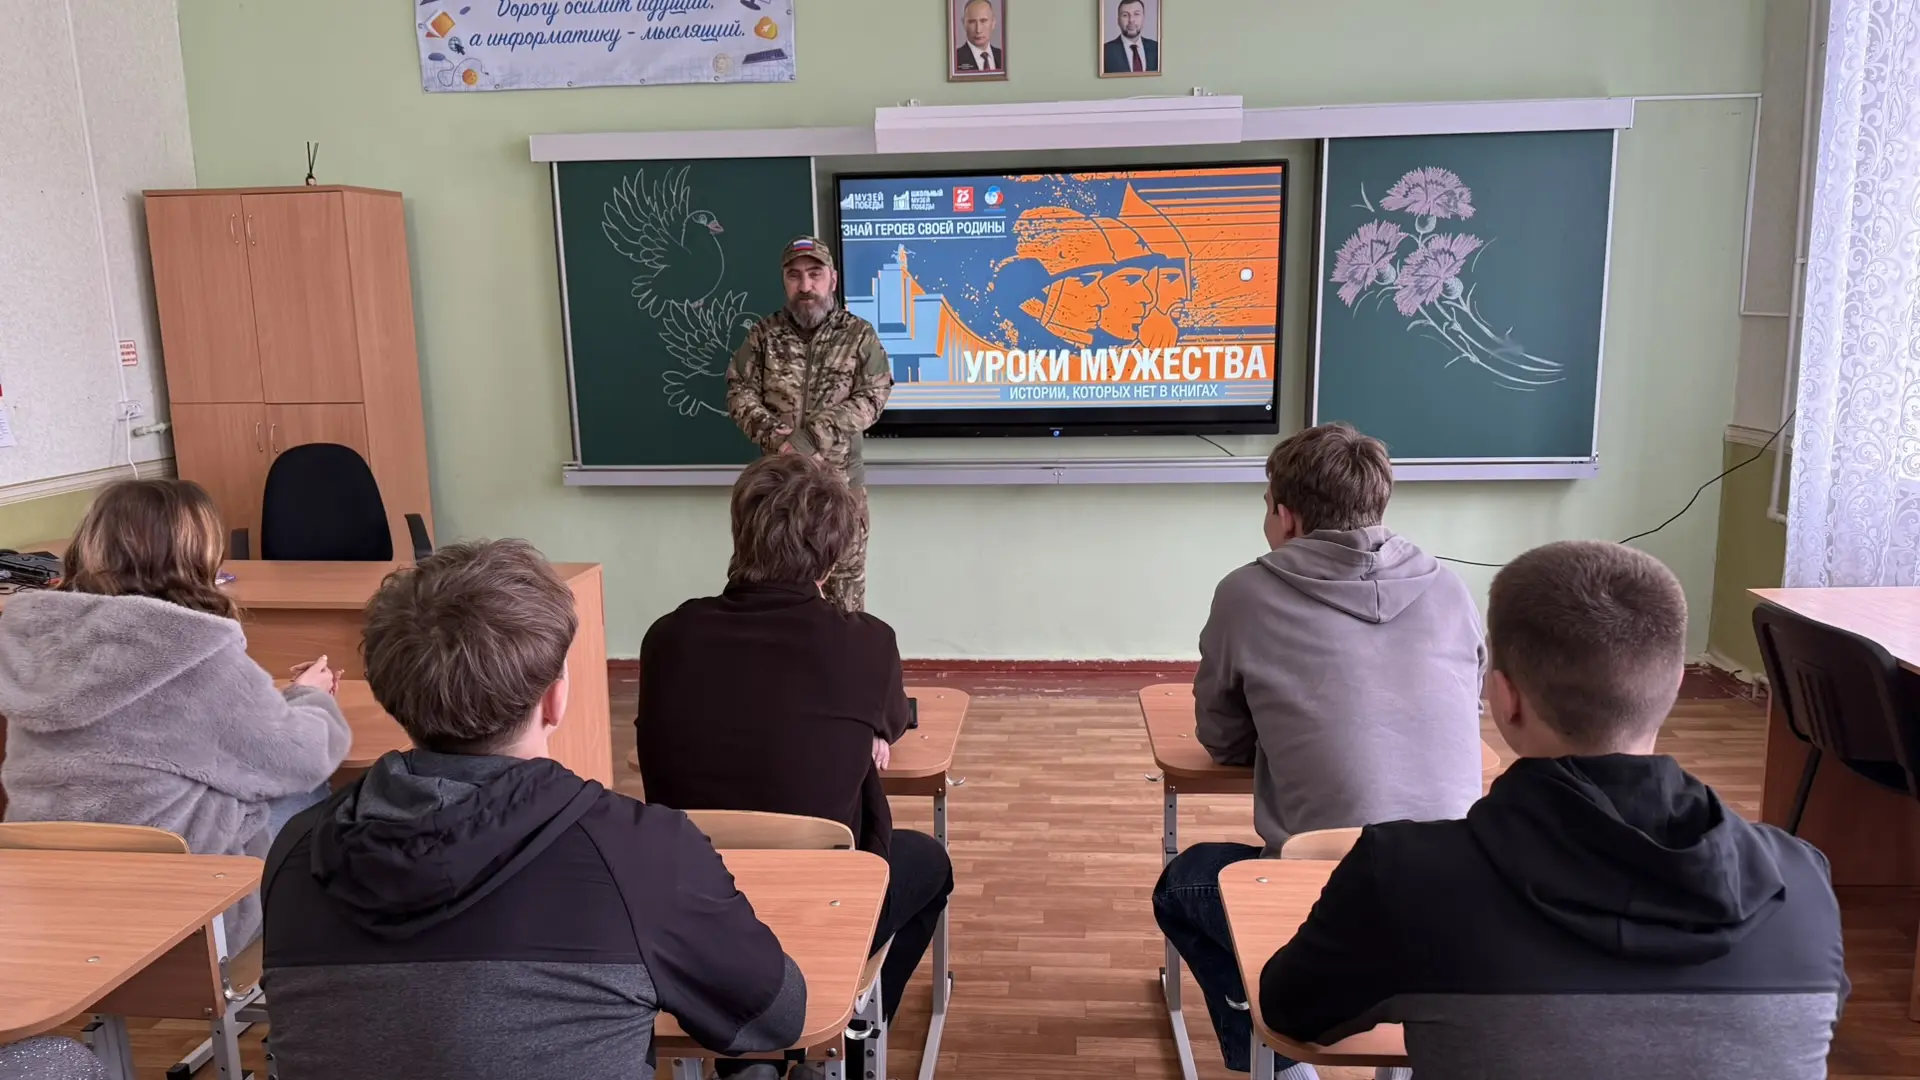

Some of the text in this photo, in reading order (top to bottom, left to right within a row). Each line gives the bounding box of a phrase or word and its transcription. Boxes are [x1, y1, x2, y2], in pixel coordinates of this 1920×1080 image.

[469, 33, 482, 46] а
[486, 28, 621, 52] информатику
[640, 20, 745, 42] мыслящий.
[854, 191, 884, 201] МУЗЕЙ
[854, 201, 885, 210] ПОБЕДЫ
[841, 220, 1005, 236] ЗНАЙ ГЕРОЕВ СВОЕЙ РОДИНЫ
[963, 345, 1267, 383] УРОКИ МУЖЕСТВА
[1009, 384, 1218, 400] ИСТОРИИ, КОТОРЫХ НЕТ В КНИГАХ
